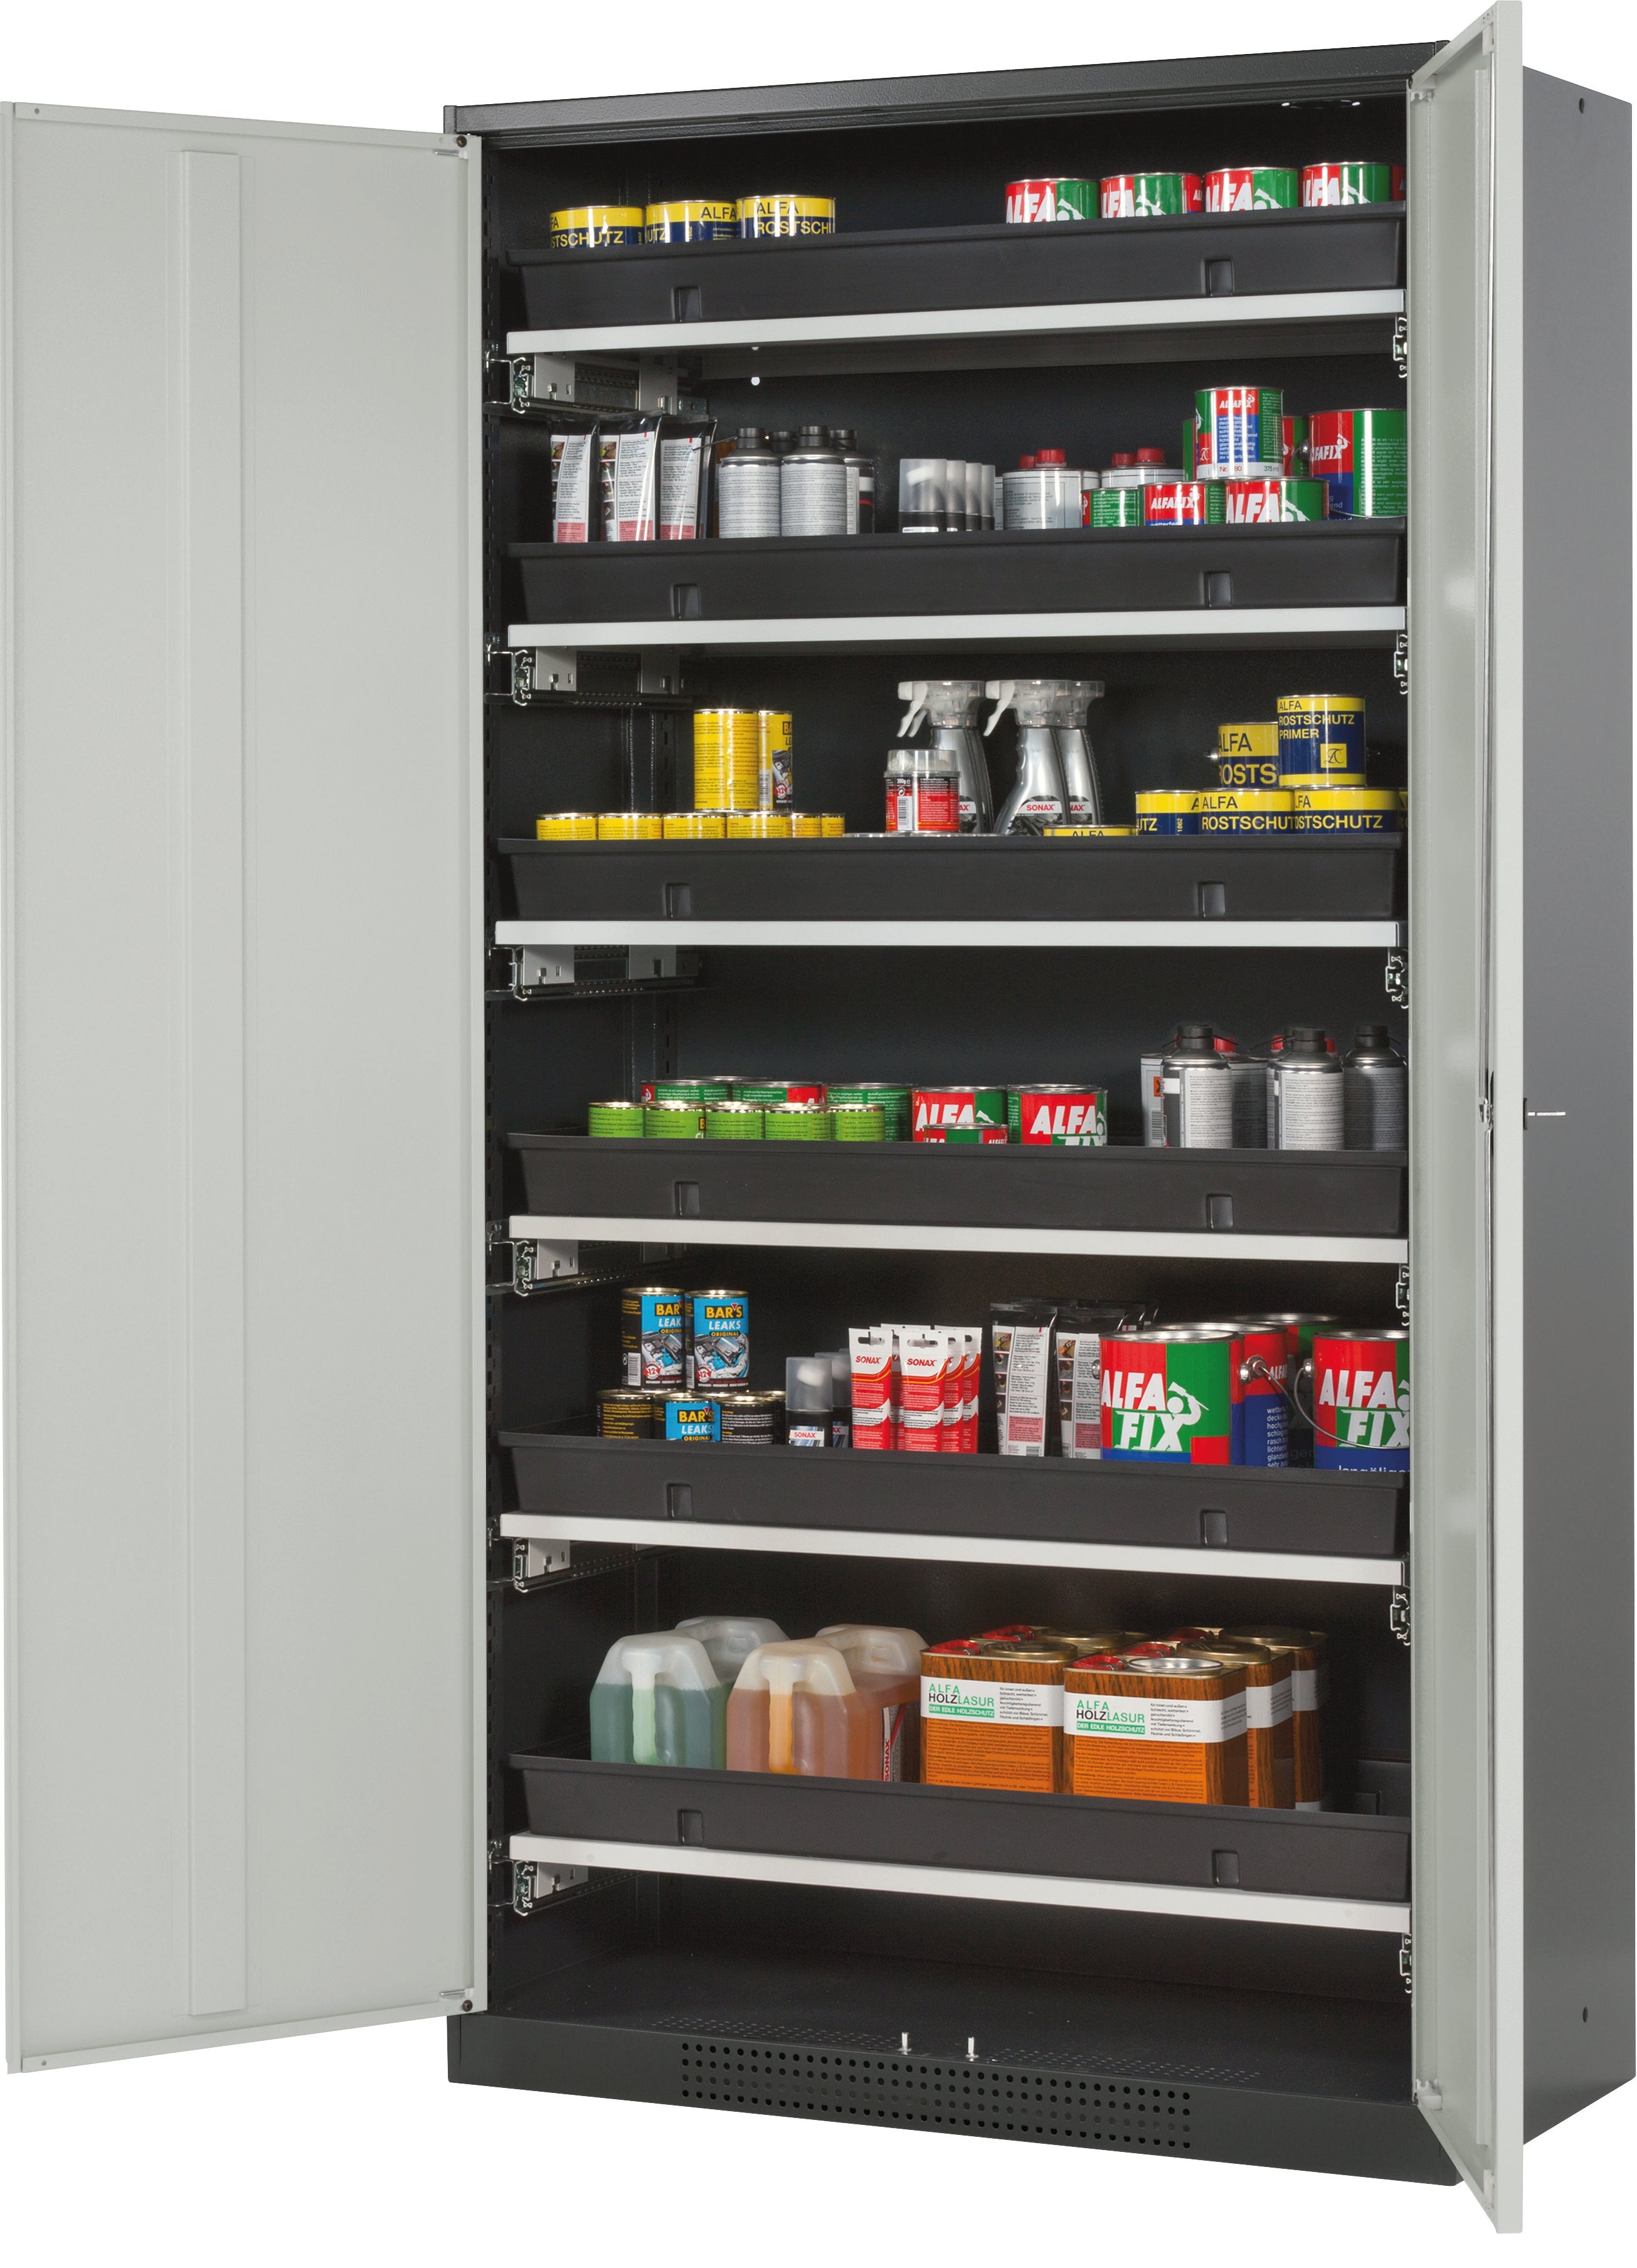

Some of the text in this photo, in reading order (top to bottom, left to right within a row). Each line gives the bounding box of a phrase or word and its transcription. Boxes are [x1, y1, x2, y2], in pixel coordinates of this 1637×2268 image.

[1205, 183, 1253, 213] ALFA
[1303, 178, 1340, 208] LFA
[757, 201, 799, 214] ALFA
[1006, 192, 1056, 223] ALFA
[1101, 189, 1136, 219] LFA
[701, 207, 736, 220] ALFA
[647, 228, 667, 243] UTZ
[1227, 493, 1281, 523] ALFA
[1279, 700, 1302, 710] ALFA
[1279, 714, 1355, 726] ROSTSCHUTZ
[1279, 728, 1319, 740] PRIMER
[1202, 796, 1238, 809] ALFA
[1295, 796, 1311, 809] FA
[915, 1103, 975, 1132] ALFA
[1030, 1105, 1097, 1135] ALFA
[709, 1320, 741, 1330] LEAKS
[856, 1355, 881, 1364] SONAX
[907, 1358, 935, 1366] SONAX
[1101, 1370, 1166, 1411] ALFA
[1319, 1368, 1397, 1408] ALFA
[681, 1424, 713, 1435] LEAKS
[1114, 1410, 1190, 1452] FIX
[929, 1683, 960, 1695] ALFA
[928, 1693, 994, 1707] HOLZLASUR
[1076, 1700, 1110, 1711] ALFA
[957, 1708, 994, 1717] HOLZSCHUTZ
[1076, 1709, 1145, 1723] HOLZLASUR
[1106, 1724, 1145, 1733] HOLZSCHUTZ
